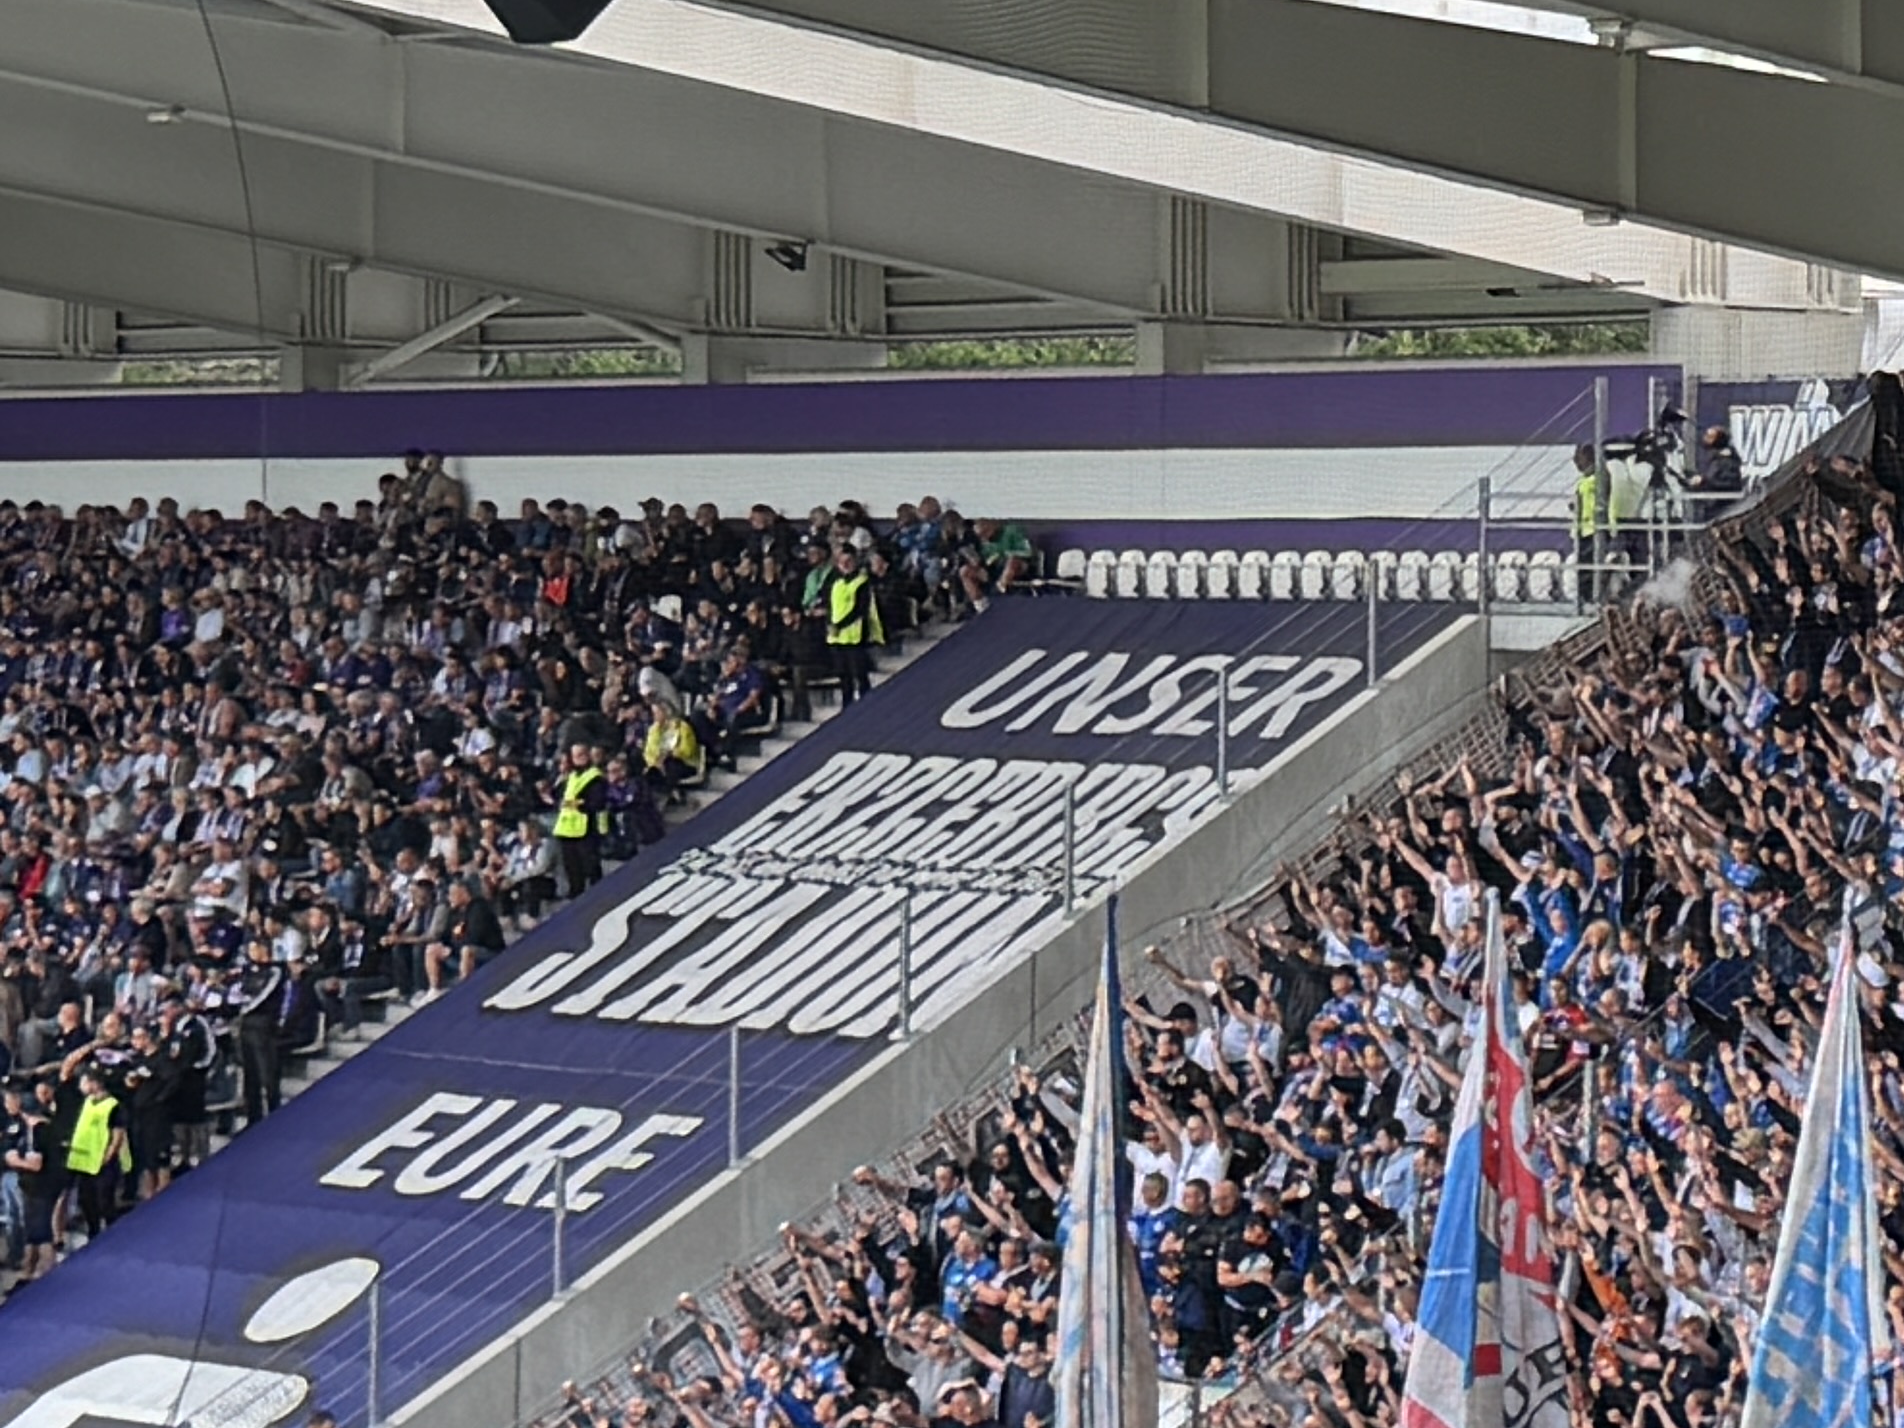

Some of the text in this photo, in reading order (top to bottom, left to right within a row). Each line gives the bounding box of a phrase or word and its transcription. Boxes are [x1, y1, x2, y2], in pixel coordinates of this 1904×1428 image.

[941, 649, 1363, 739] UNSER
[485, 871, 1085, 1039] STADION
[319, 1091, 704, 1212] EURE
